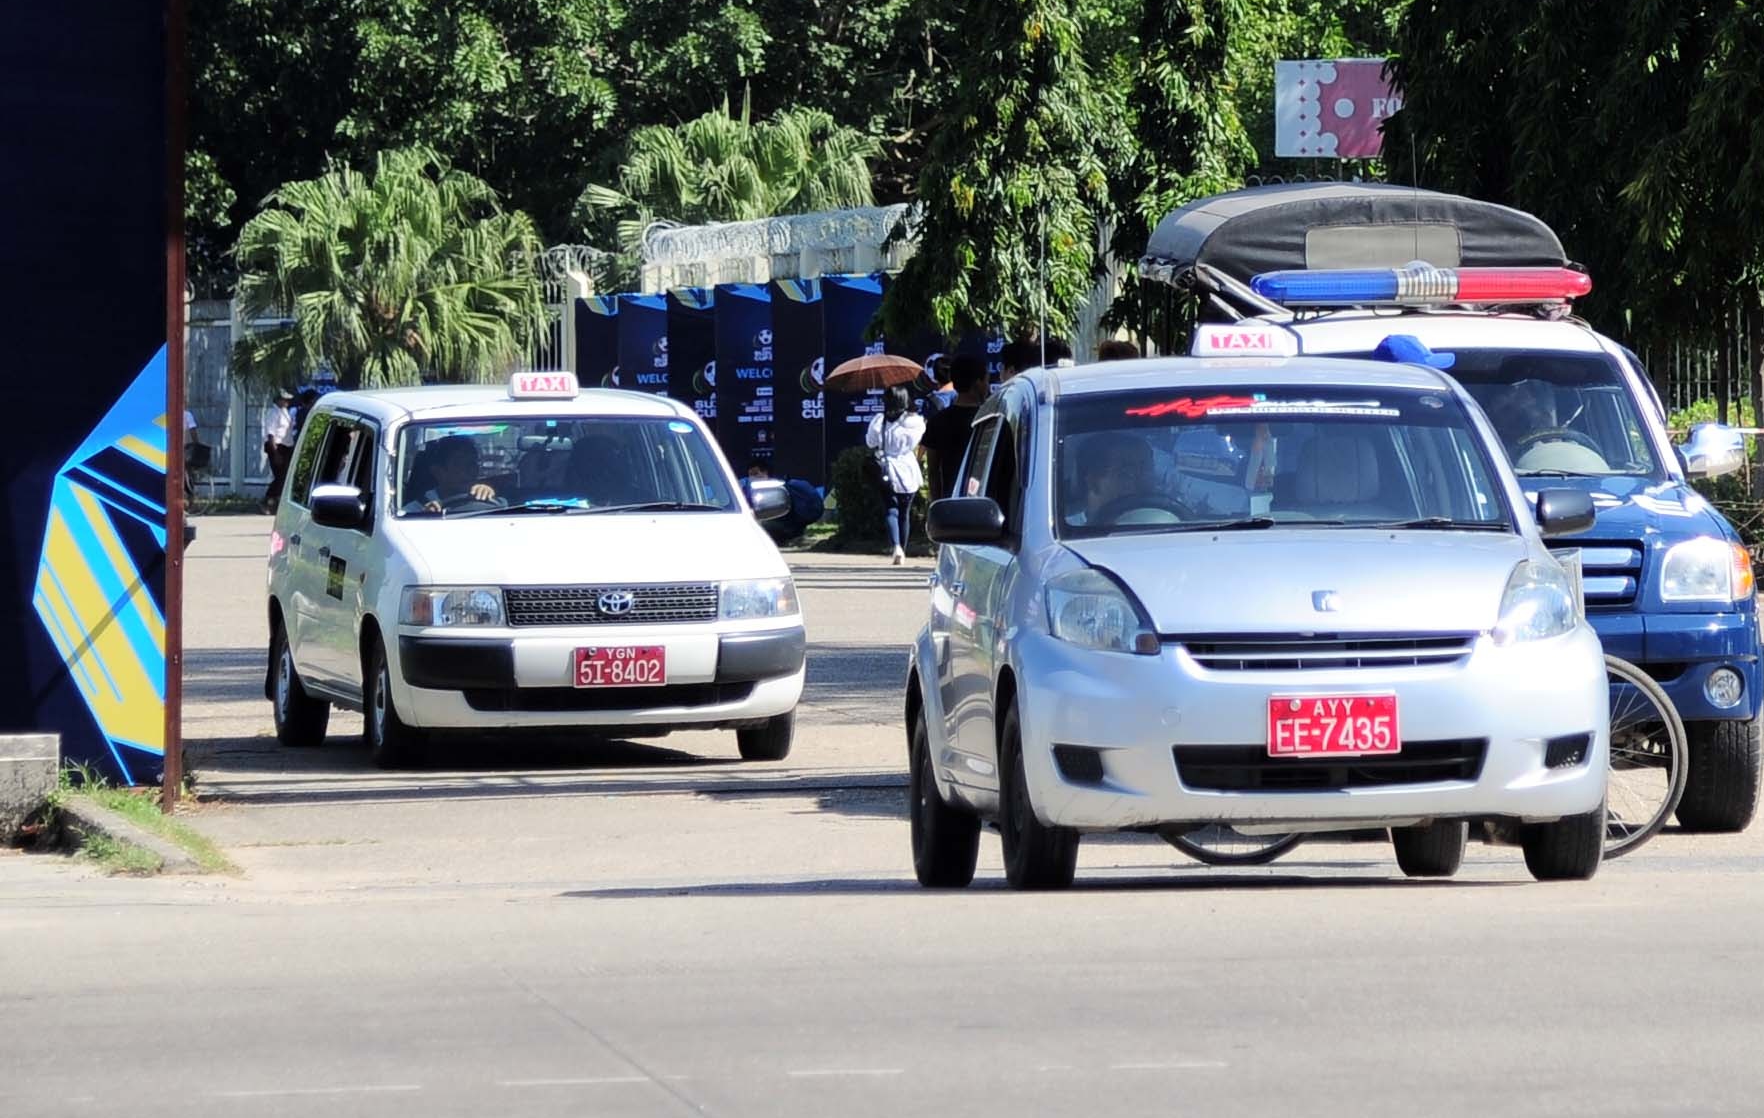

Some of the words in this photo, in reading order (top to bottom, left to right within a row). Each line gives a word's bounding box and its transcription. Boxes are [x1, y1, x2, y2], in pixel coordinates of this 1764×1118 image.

[1211, 333, 1272, 349] TAXI
[520, 377, 568, 392] TAXI
[605, 648, 636, 660] YGN
[580, 660, 660, 684] 5I-8402
[1313, 699, 1354, 717] AYY
[1275, 716, 1392, 752] EE-7435
